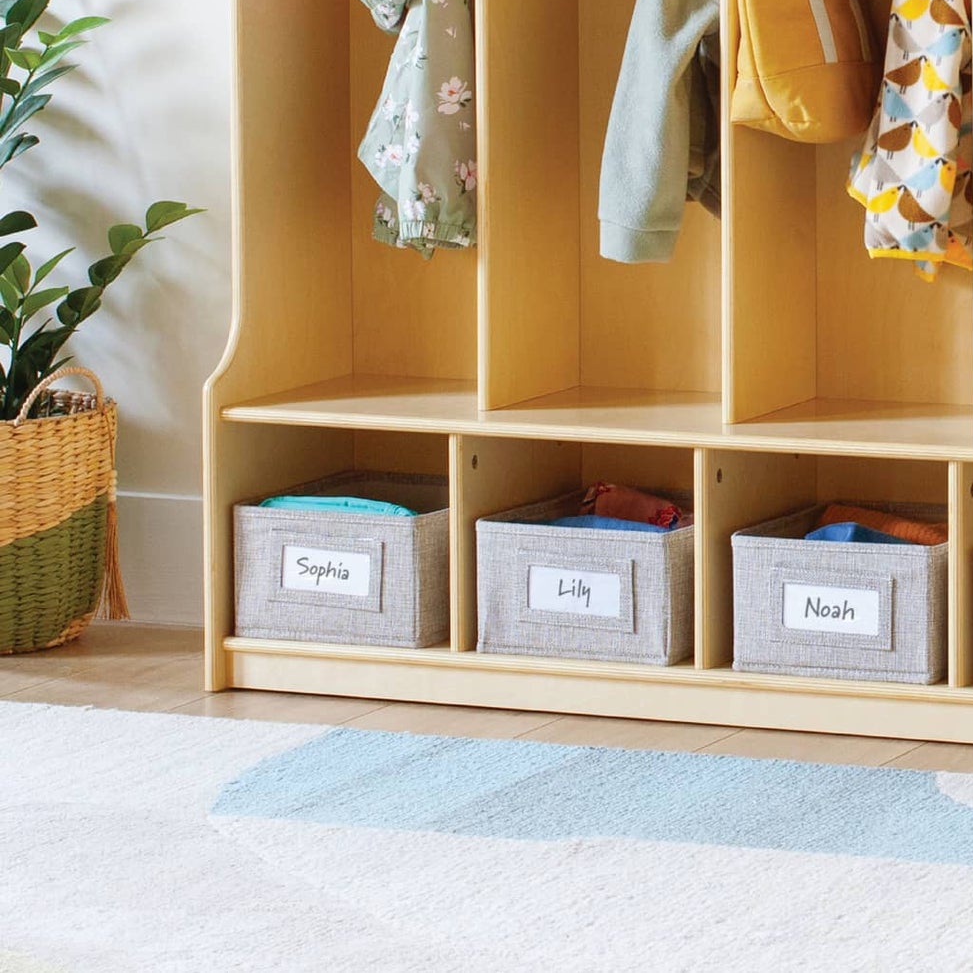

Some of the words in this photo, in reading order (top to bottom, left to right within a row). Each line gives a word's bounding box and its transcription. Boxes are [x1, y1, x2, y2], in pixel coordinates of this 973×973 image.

[296, 556, 350, 586] Sophia
[558, 578, 591, 608] Lily
[804, 596, 855, 620] Noah
